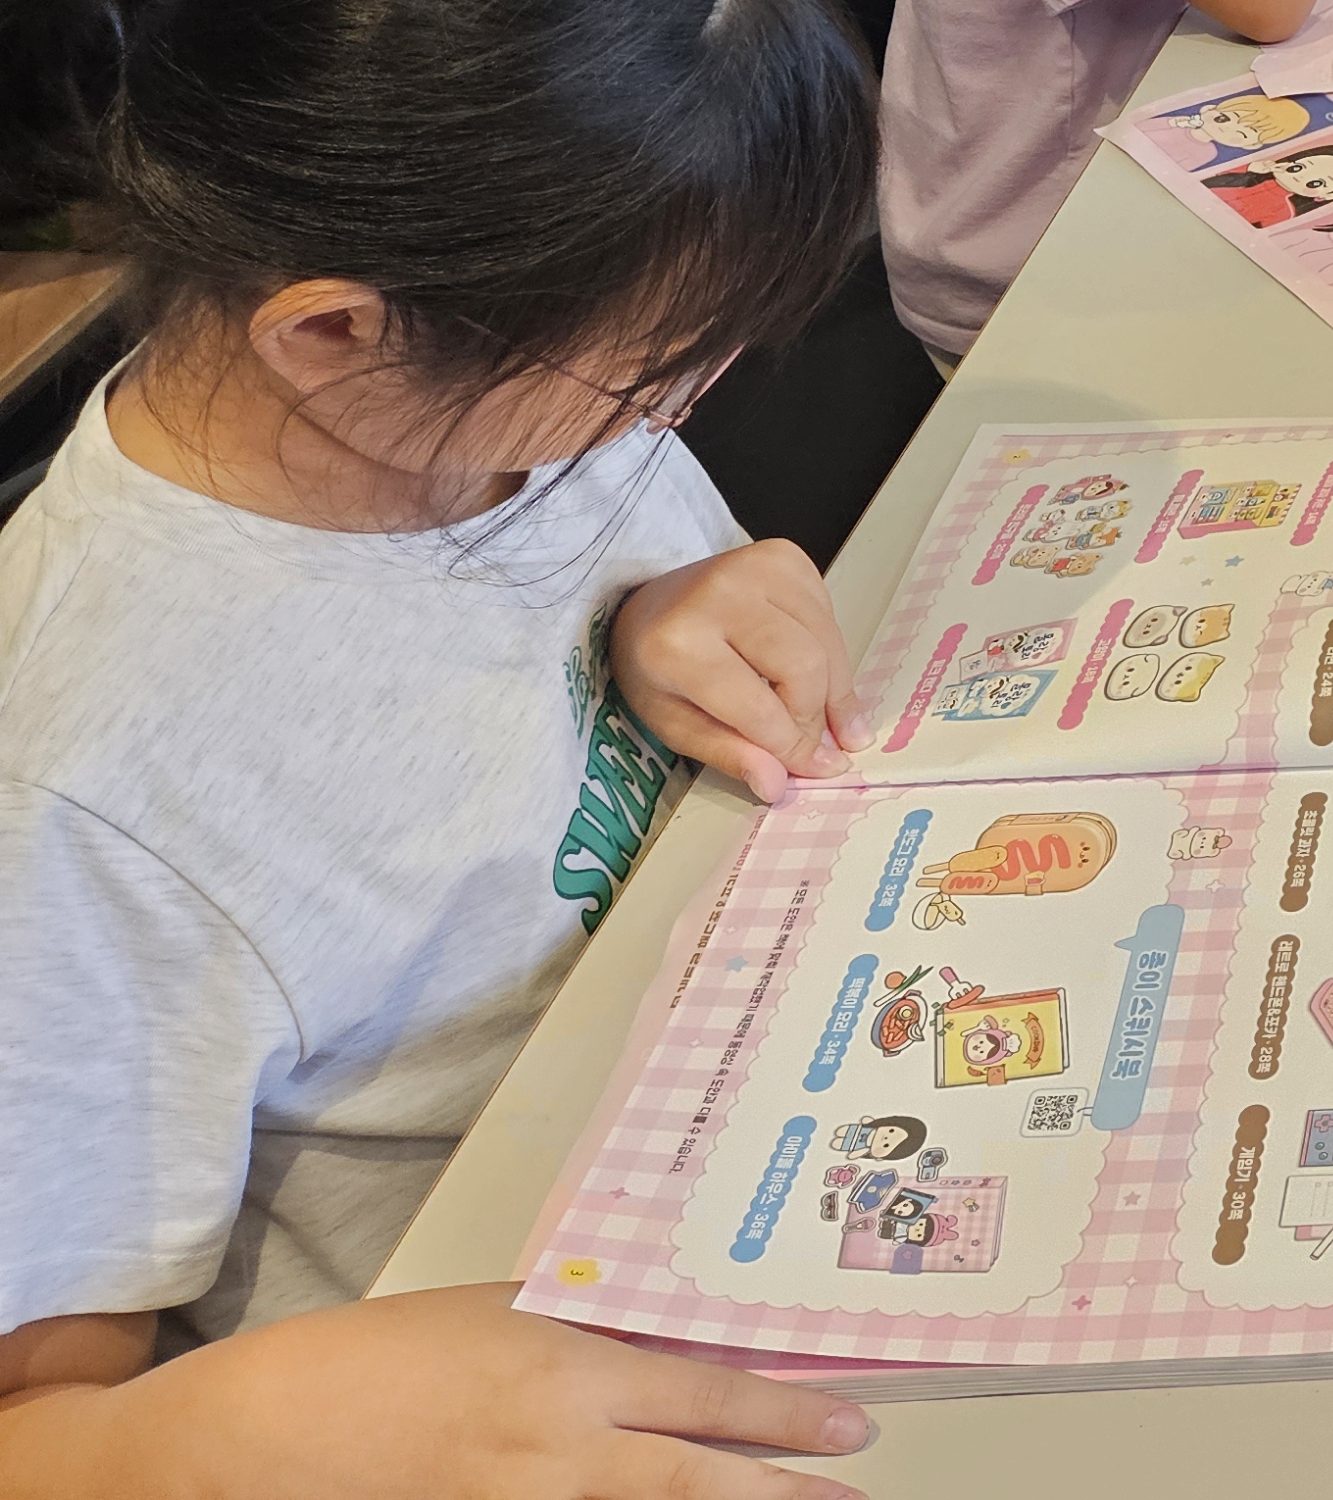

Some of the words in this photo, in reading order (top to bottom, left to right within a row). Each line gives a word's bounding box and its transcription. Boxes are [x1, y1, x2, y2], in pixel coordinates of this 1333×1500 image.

[1299, 809, 1319, 836] 초콜릿
[896, 828, 921, 857] 핫도그
[1294, 836, 1312, 858] 과자
[889, 857, 909, 878] 요리
[1289, 863, 1306, 888] 26쪽
[792, 889, 807, 905] 모든
[878, 882, 899, 908] 32쪽
[780, 907, 800, 931] 도안은
[1135, 949, 1167, 990] 종이
[1273, 940, 1294, 973] 레트로
[842, 976, 866, 1009] 떡볶이
[733, 1013, 755, 1039] 때문에
[832, 1010, 853, 1033] 요리
[1110, 997, 1156, 1080] 스퀴시북
[720, 1040, 742, 1066] 동영상
[819, 1040, 843, 1067] 34쪽
[1255, 1045, 1275, 1074] 28쪽
[702, 1078, 725, 1105] 도안과
[692, 1106, 711, 1124] 다를
[668, 1137, 696, 1174] 있습니다.
[1234, 1145, 1257, 1183] 게임기
[759, 1171, 788, 1205] 하우스
[1227, 1190, 1247, 1221] 30쪽
[745, 1213, 770, 1240] 36쪽
